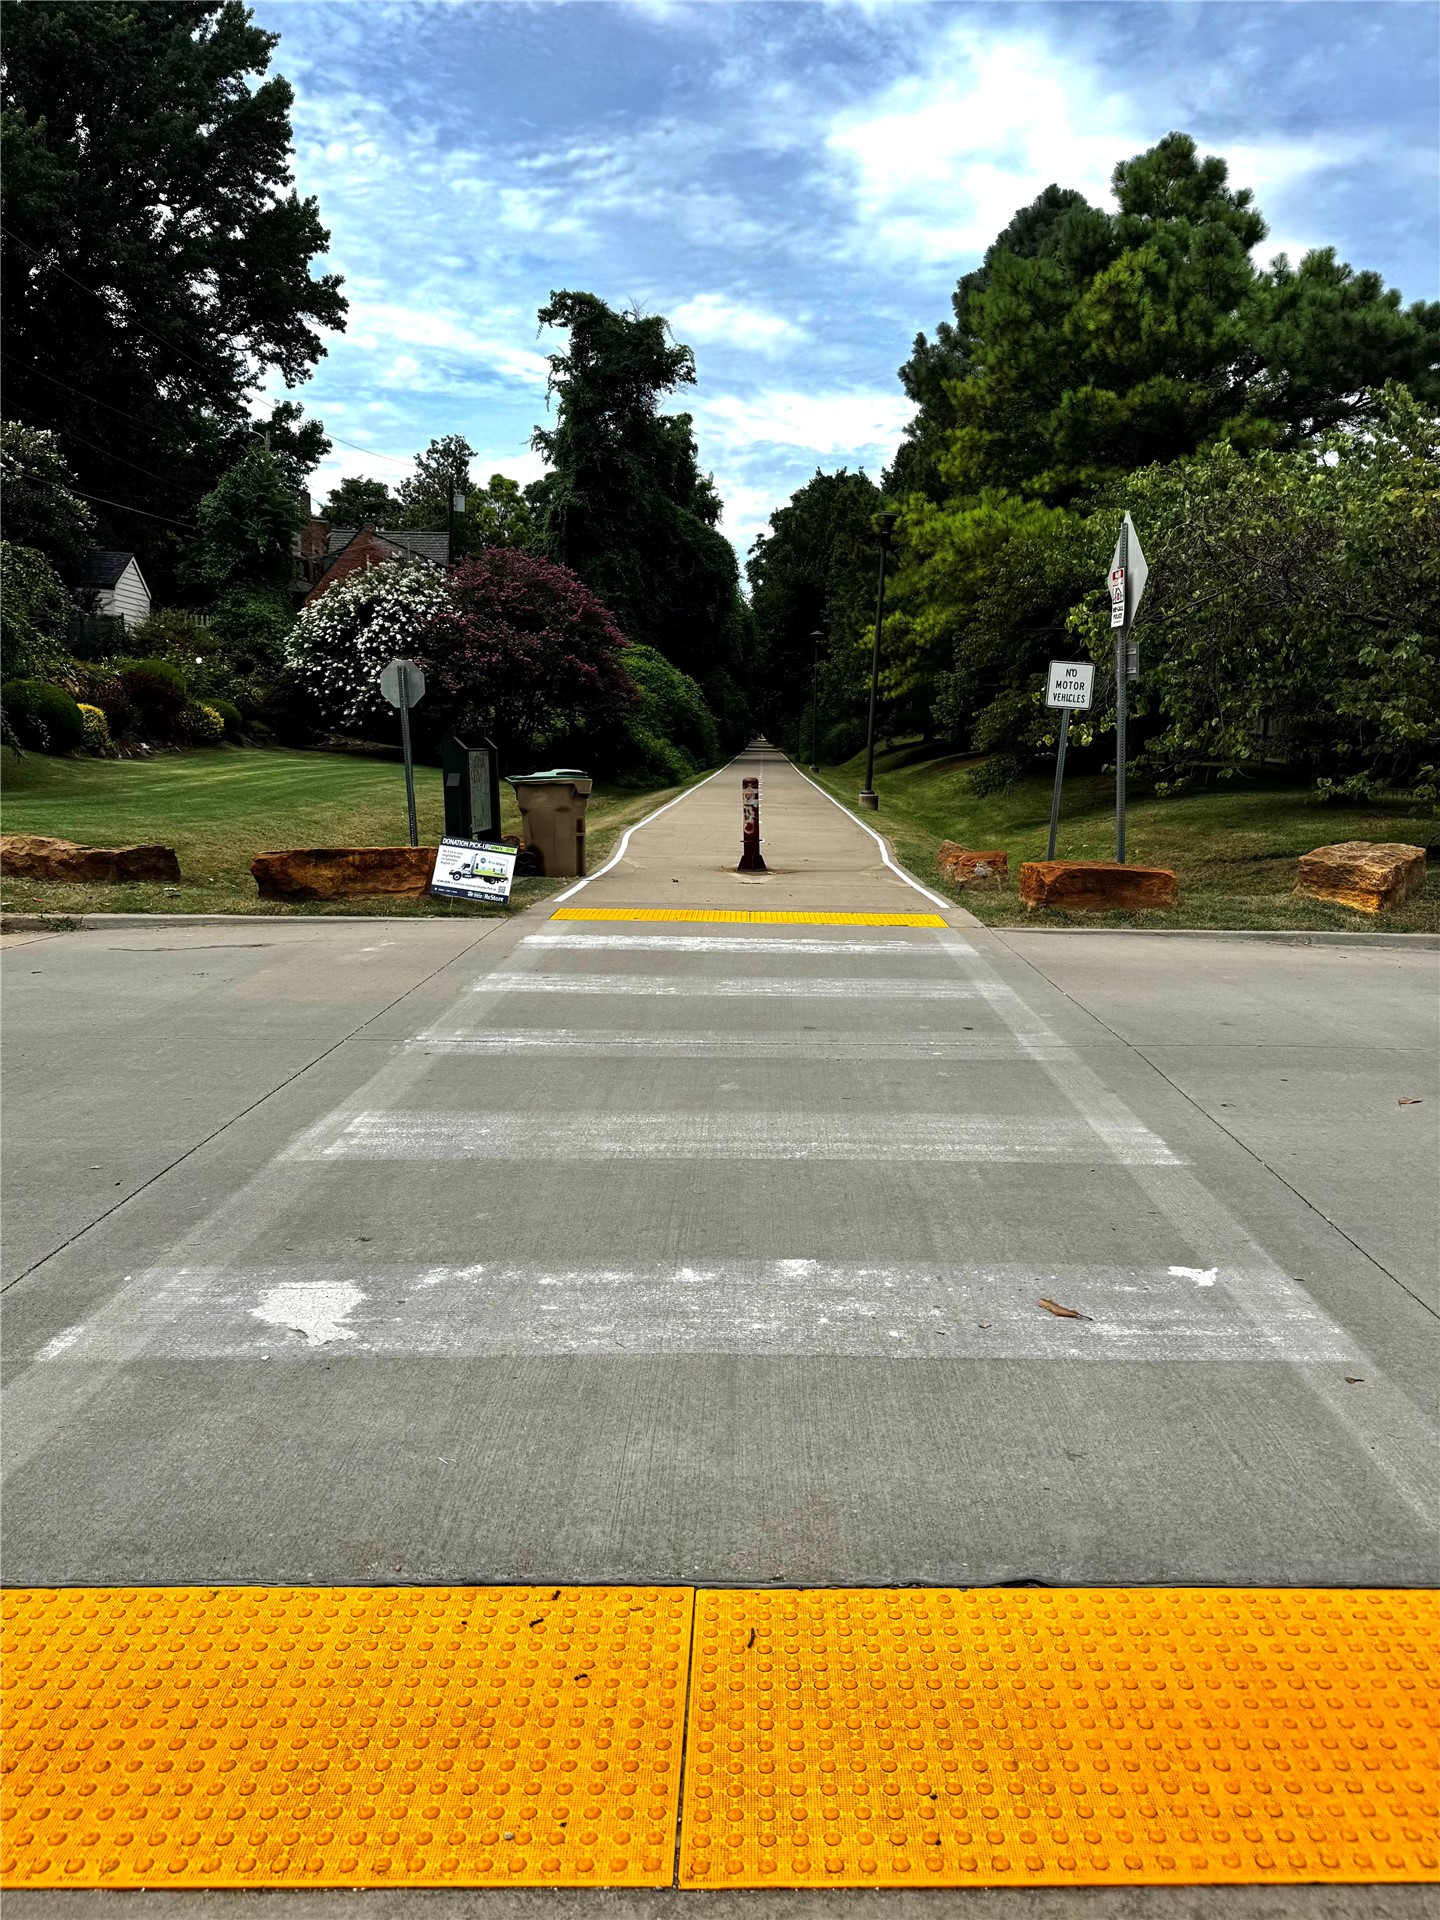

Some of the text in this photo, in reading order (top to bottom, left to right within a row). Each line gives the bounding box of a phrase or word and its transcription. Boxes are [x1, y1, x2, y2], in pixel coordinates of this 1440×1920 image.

[1065, 668, 1078, 678] NO
[1055, 680, 1085, 691] MOTOR
[1052, 692, 1086, 704] VEHICLES
[442, 838, 491, 850] DONATION PICK-UP
[484, 893, 504, 903] ReStore
